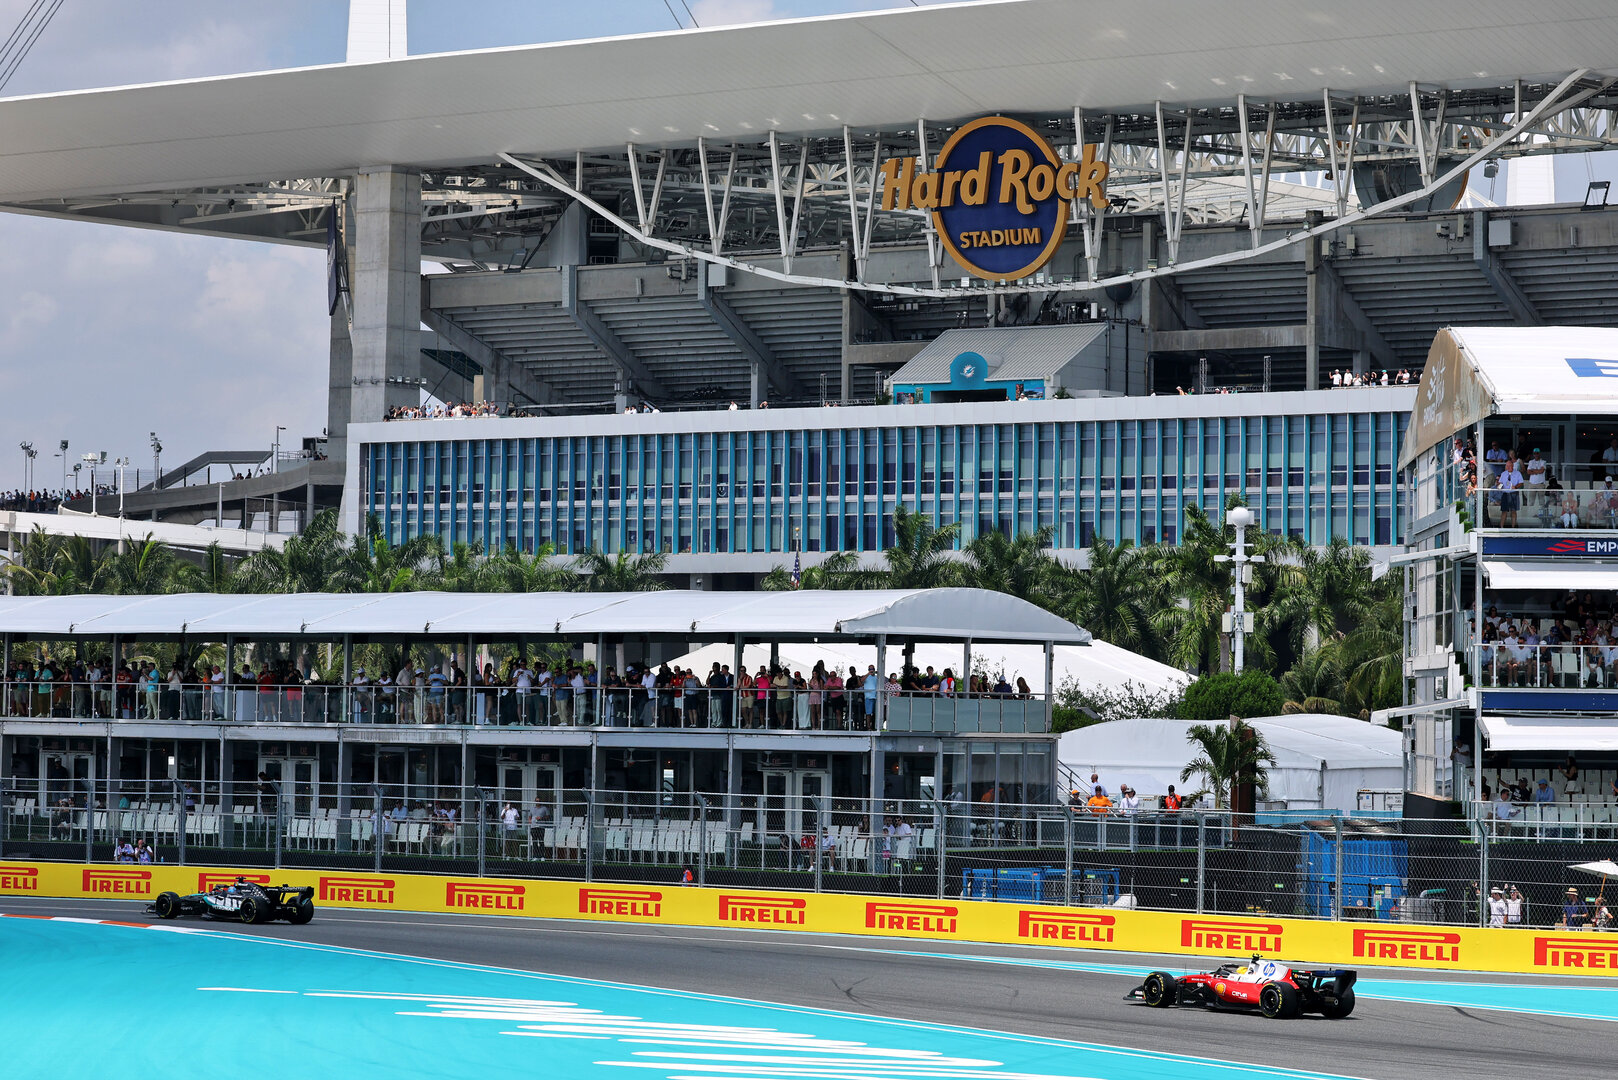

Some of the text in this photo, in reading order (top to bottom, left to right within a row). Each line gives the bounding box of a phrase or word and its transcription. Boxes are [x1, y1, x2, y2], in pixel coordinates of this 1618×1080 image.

[880, 143, 1110, 215] Hard Rock
[959, 227, 1042, 249] STADIUM
[1587, 541, 1618, 553] EMP
[82, 869, 152, 894] PIRELLI
[319, 876, 395, 904] PIRELLI
[446, 882, 525, 910] PIRELLI
[579, 888, 662, 917] PIRELLI
[719, 895, 806, 925] PIRELLI
[866, 902, 958, 933] PIRELLI
[1019, 910, 1115, 942] PIRELLI
[1181, 919, 1284, 952] PIRELLI
[1353, 928, 1461, 962] PIRELLI
